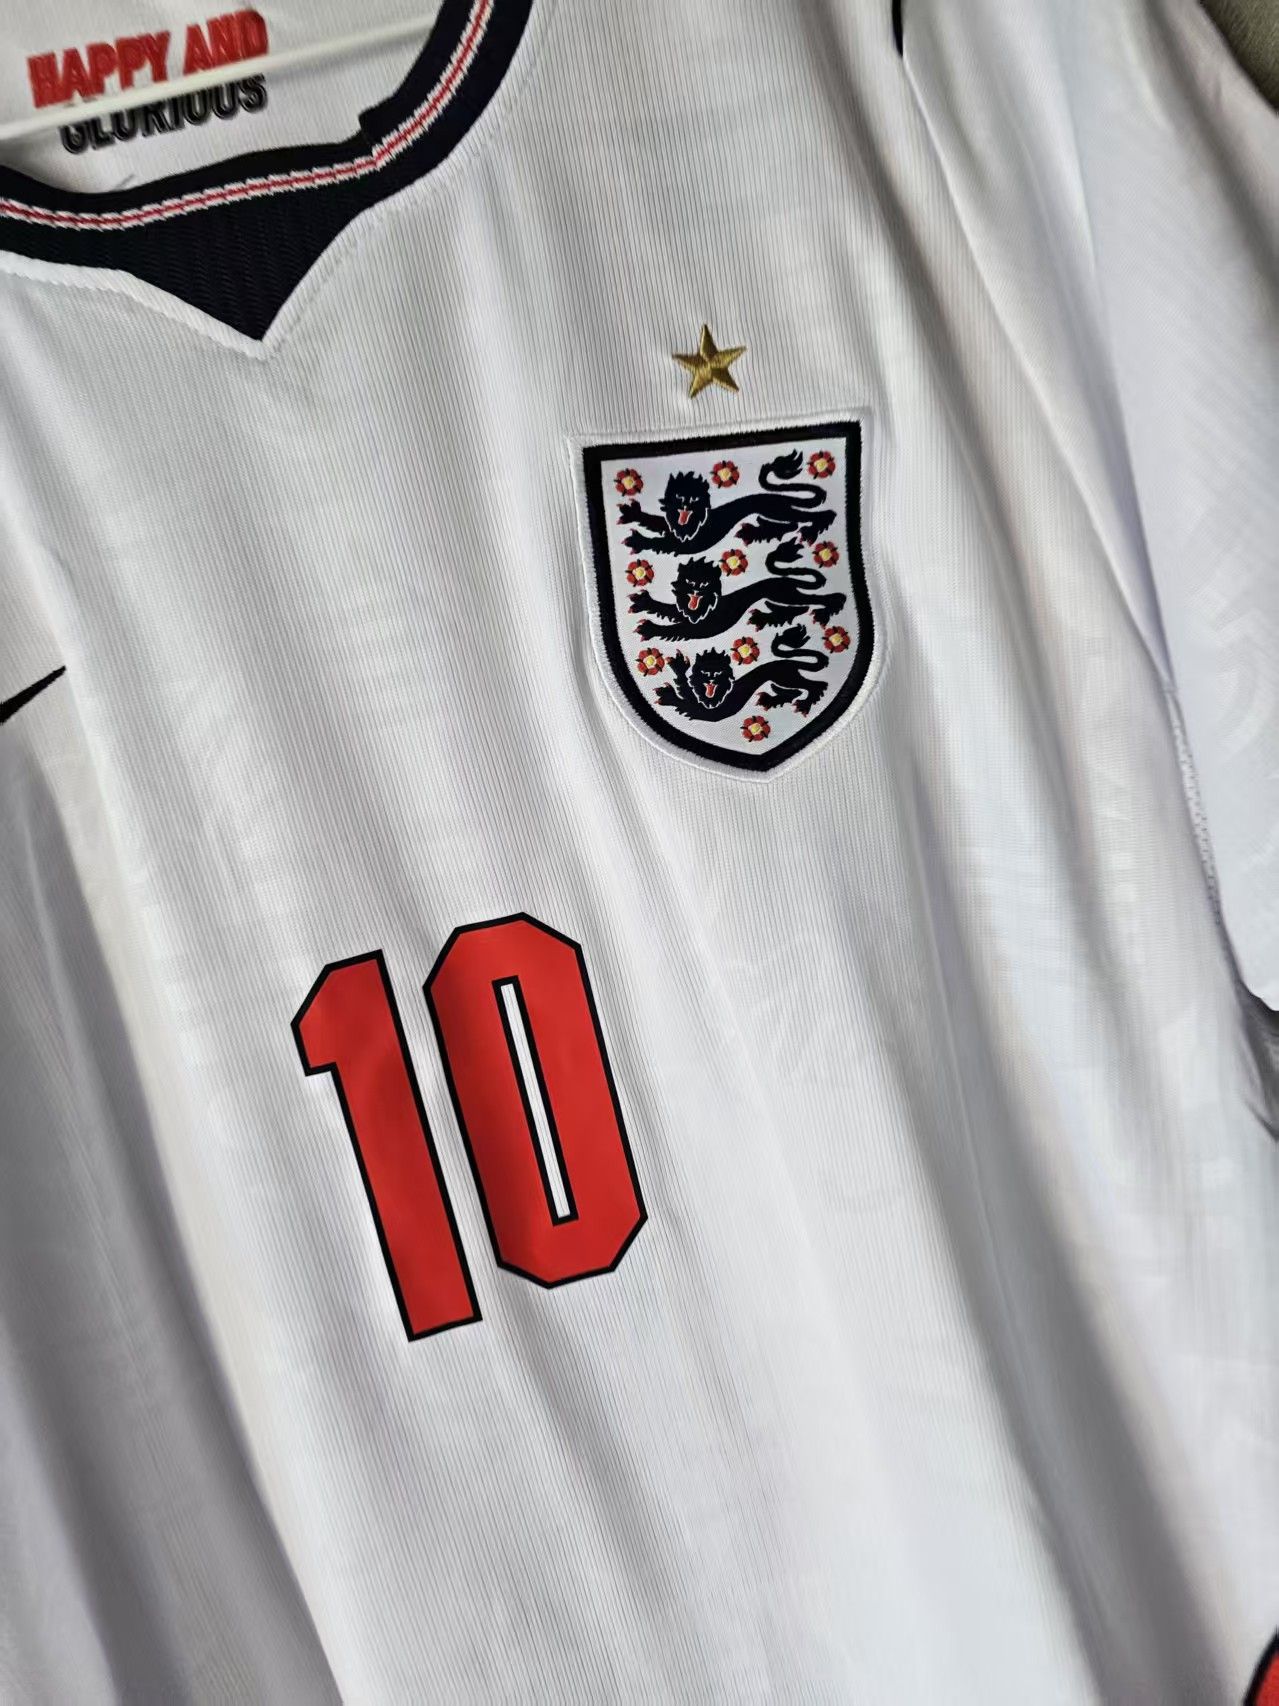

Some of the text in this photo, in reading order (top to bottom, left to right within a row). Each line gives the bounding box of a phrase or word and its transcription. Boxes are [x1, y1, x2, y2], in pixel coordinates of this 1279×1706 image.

[27, 9, 269, 109] HAPPY AND
[58, 73, 268, 155] GLORIOUS
[291, 912, 648, 1342] 10
